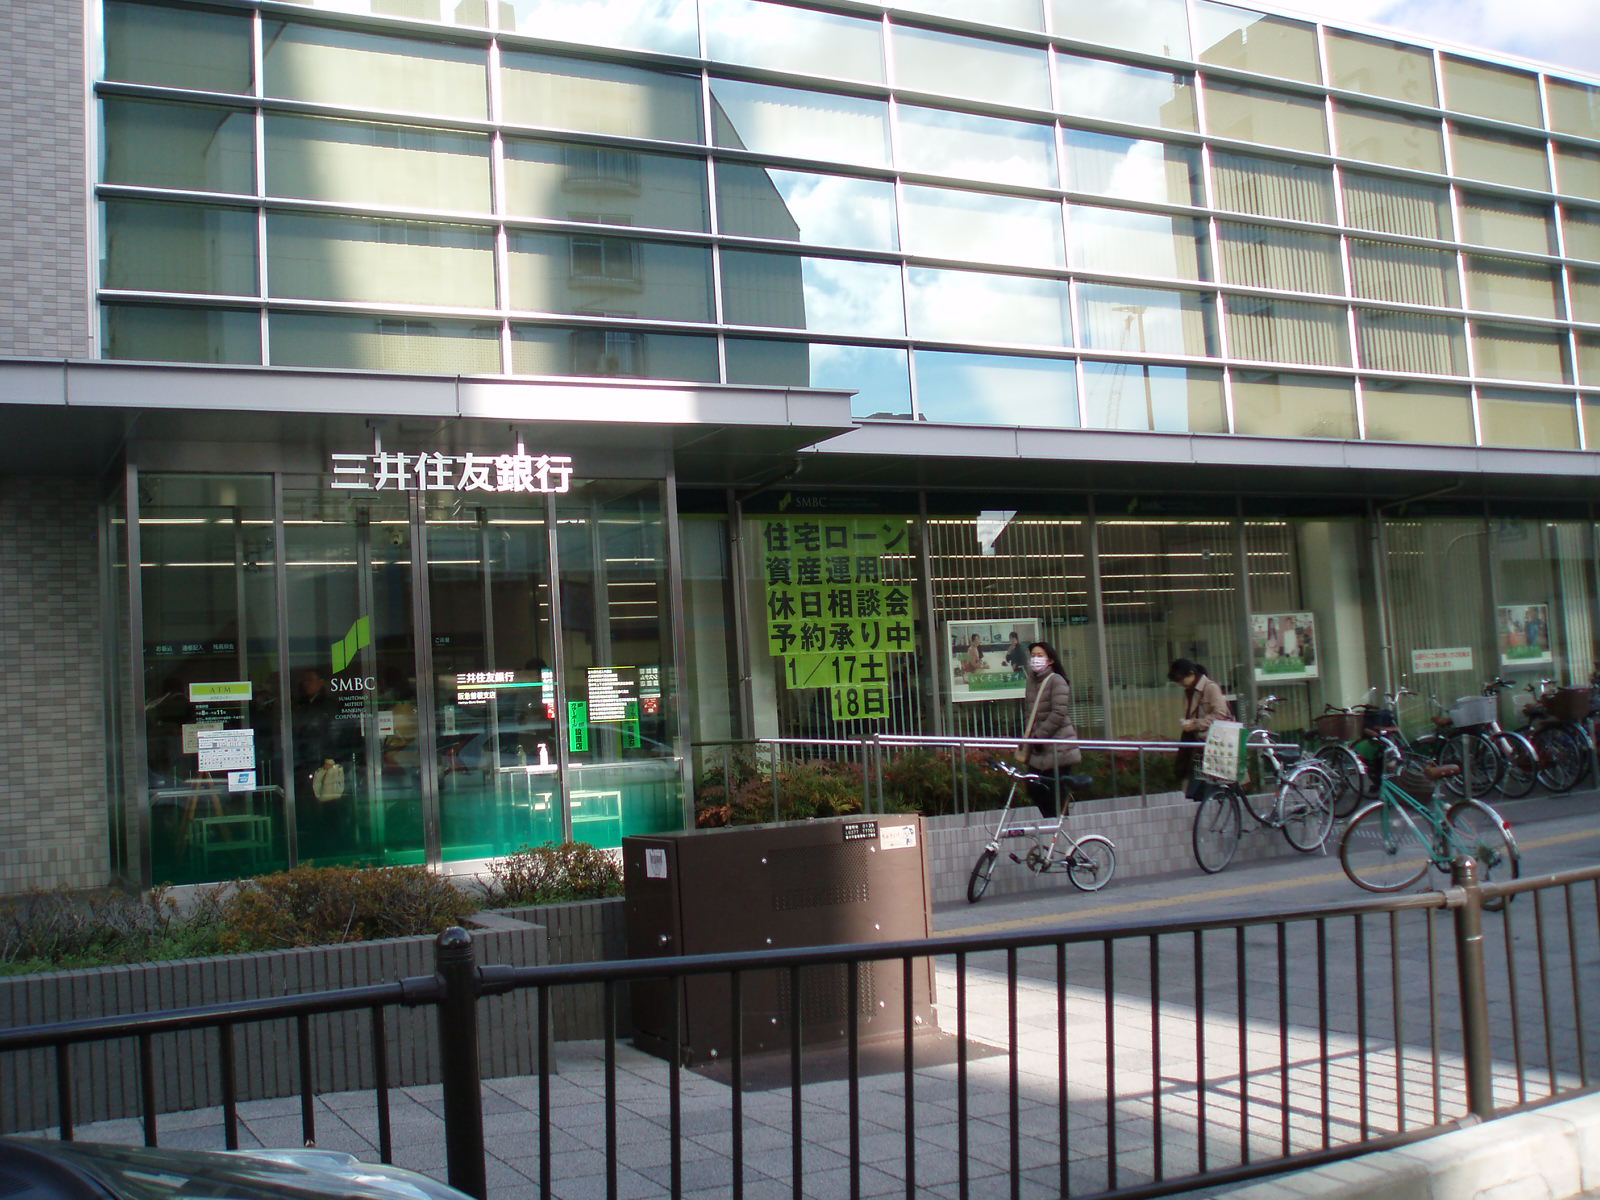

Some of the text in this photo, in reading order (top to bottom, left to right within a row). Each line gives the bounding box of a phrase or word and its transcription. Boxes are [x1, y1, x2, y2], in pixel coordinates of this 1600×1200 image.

[331, 451, 573, 492] 三井住友銀行
[795, 496, 826, 507] SMBC
[763, 522, 905, 551] 住宅ローン
[766, 556, 879, 586] 資産運用
[768, 588, 909, 620] 休日相談会
[771, 621, 911, 652] 予約承り中
[209, 686, 232, 694] ATM
[330, 676, 376, 692] SMBC
[456, 671, 515, 684] 三井住友銀行
[834, 688, 884, 716] 18日
